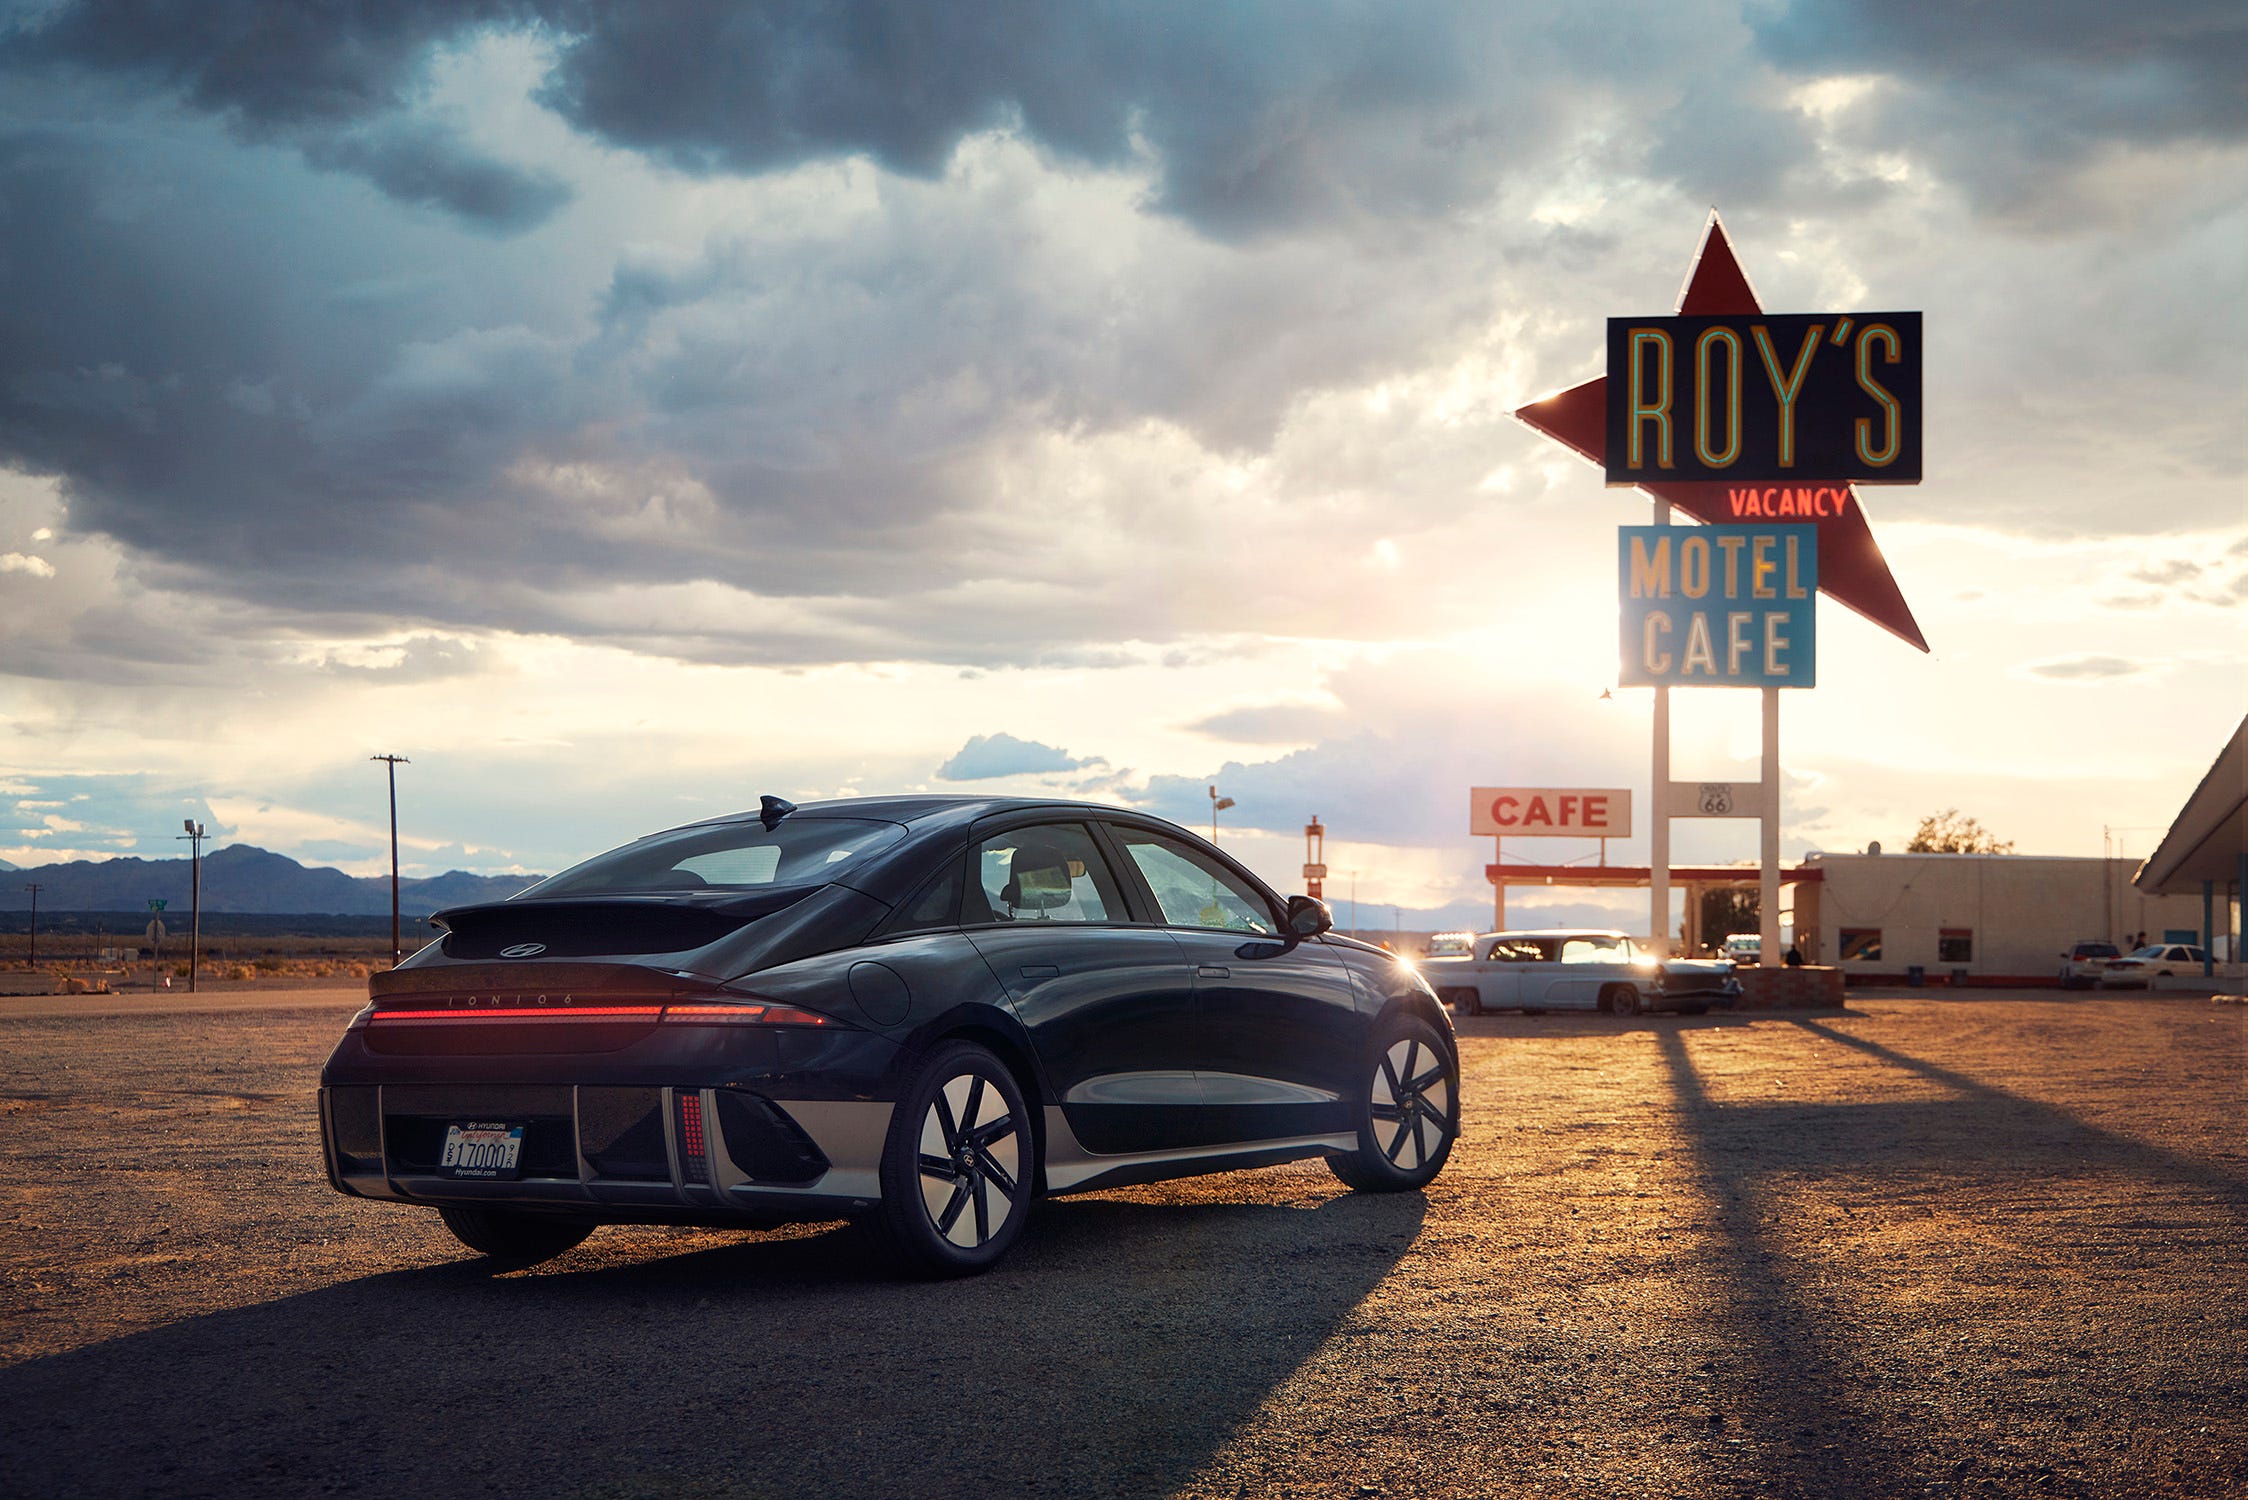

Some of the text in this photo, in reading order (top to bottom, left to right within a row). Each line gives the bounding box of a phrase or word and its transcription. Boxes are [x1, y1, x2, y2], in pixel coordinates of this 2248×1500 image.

[1627, 317, 1901, 469] ROY'S
[1729, 488, 1848, 517] VACANCY
[1630, 535, 1807, 599] MOTEL
[1643, 610, 1790, 676] CAFE
[1491, 796, 1608, 827] CAFE
[1705, 798, 1726, 812] 66
[564, 994, 572, 1004] 6
[457, 1143, 506, 1168] 17000
[455, 1168, 497, 1177] Hyundai.com
